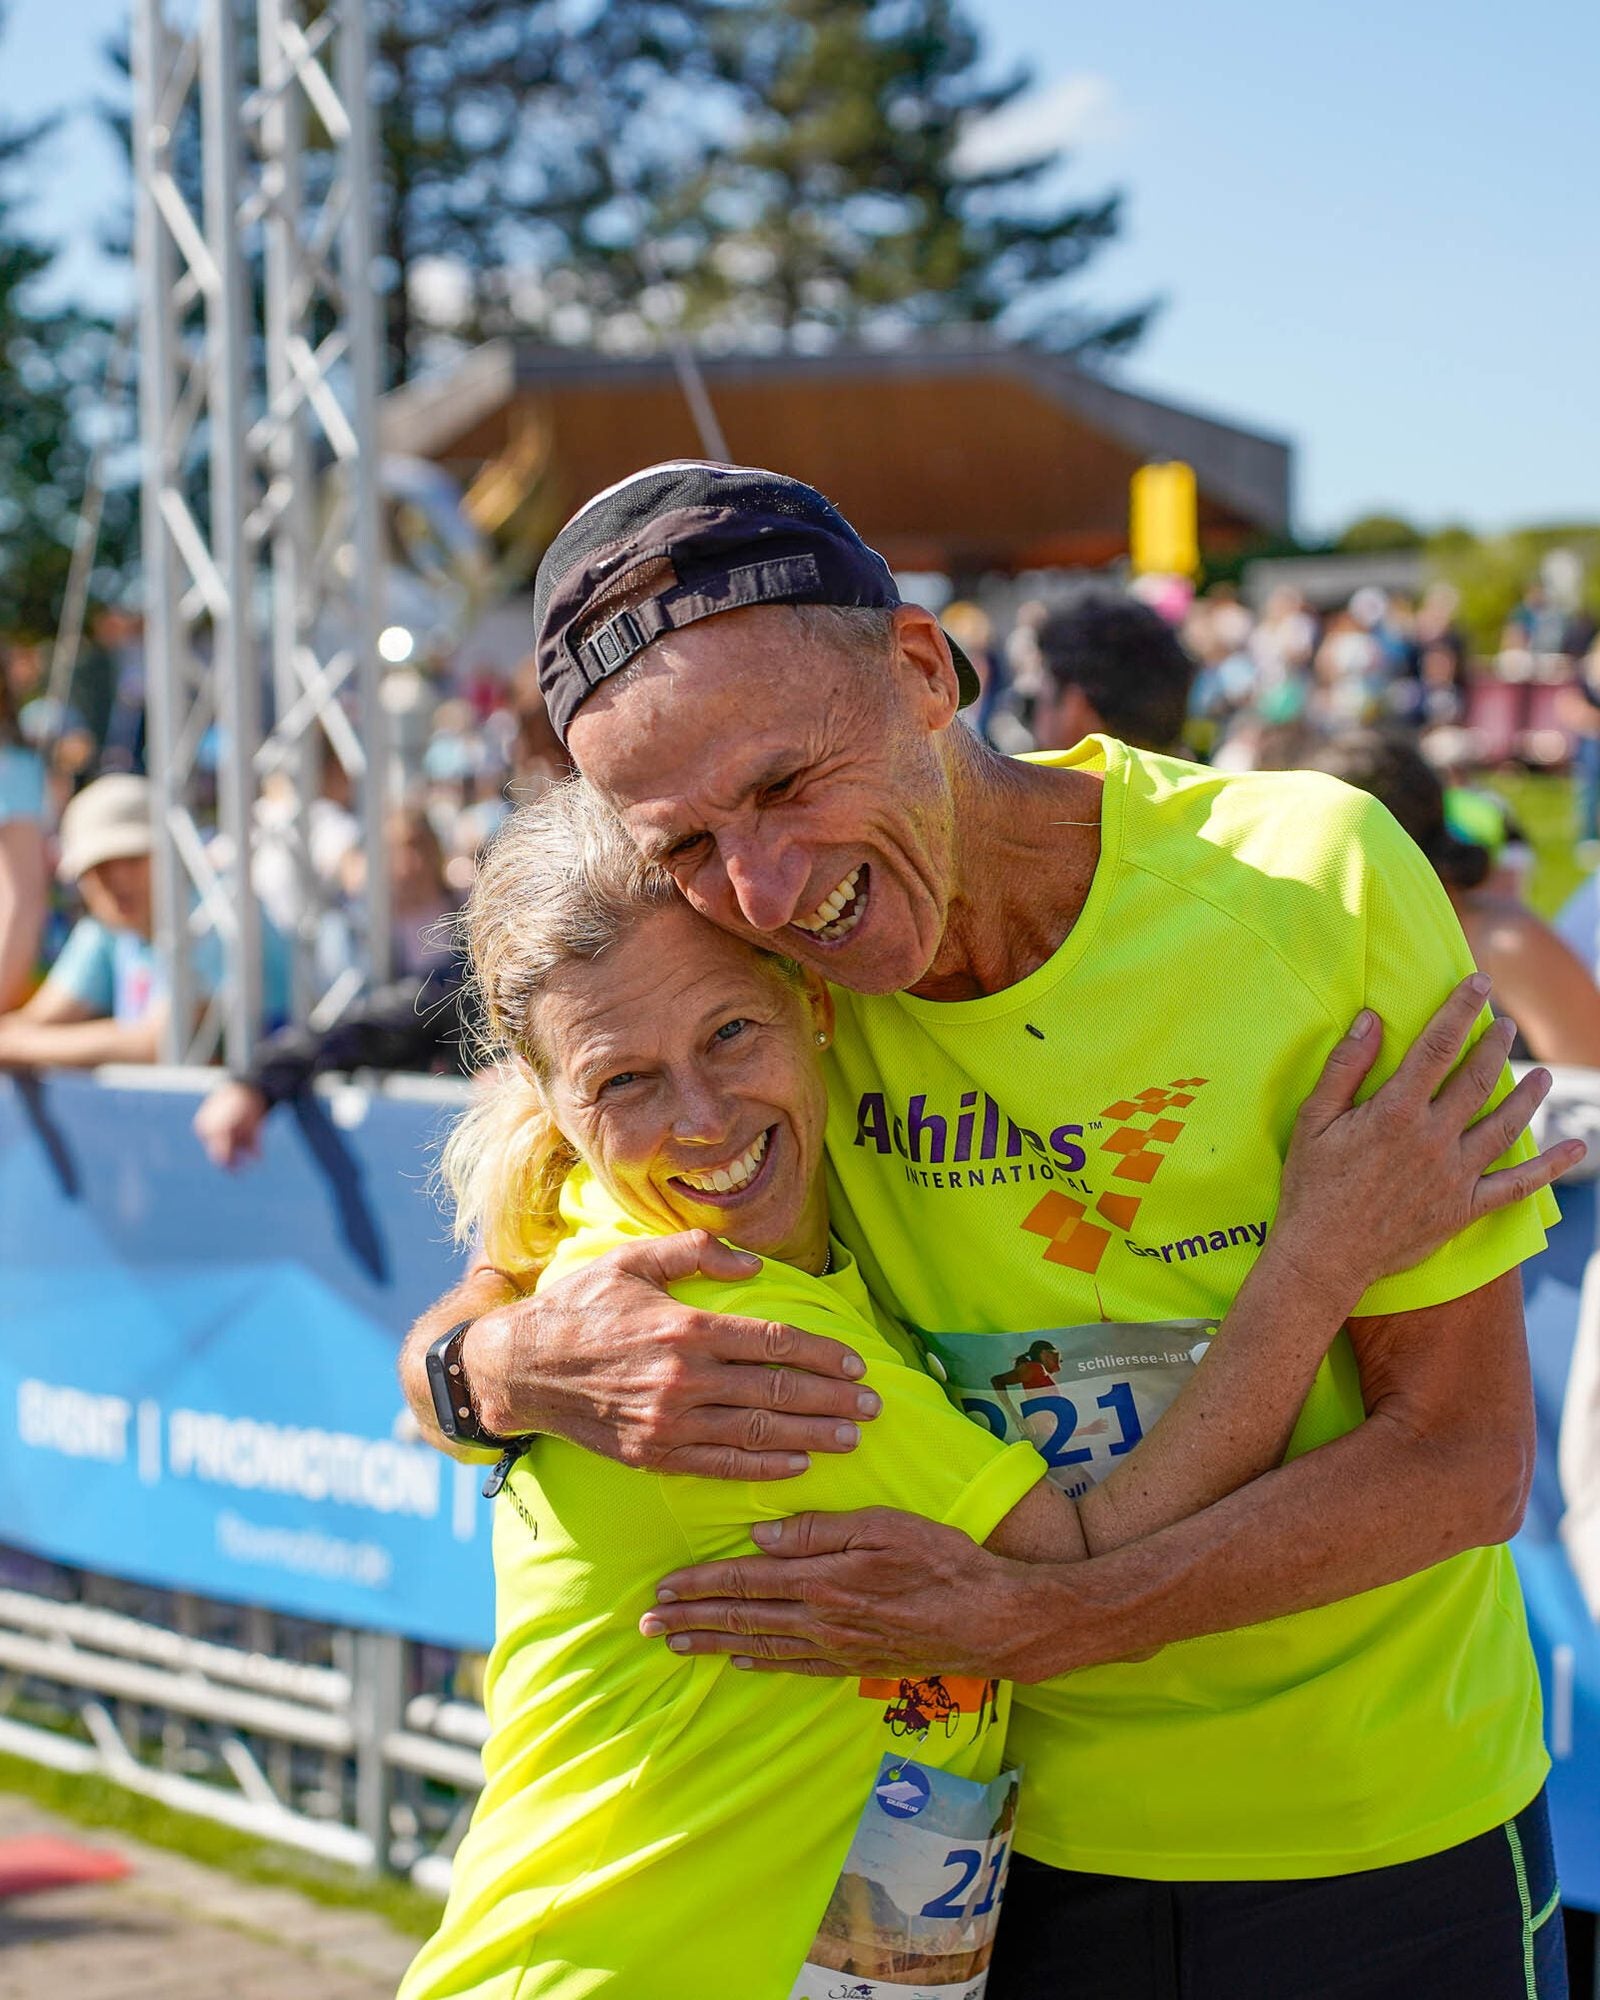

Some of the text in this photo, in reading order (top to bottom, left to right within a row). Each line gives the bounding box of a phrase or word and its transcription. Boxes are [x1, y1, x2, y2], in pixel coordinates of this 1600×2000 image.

[905, 1162, 1093, 1195] INTERNATIOAL
[1124, 1220, 1267, 1264] Germany
[1077, 1349, 1193, 1373] schliersee-lau
[920, 1841, 1009, 1919] 21
